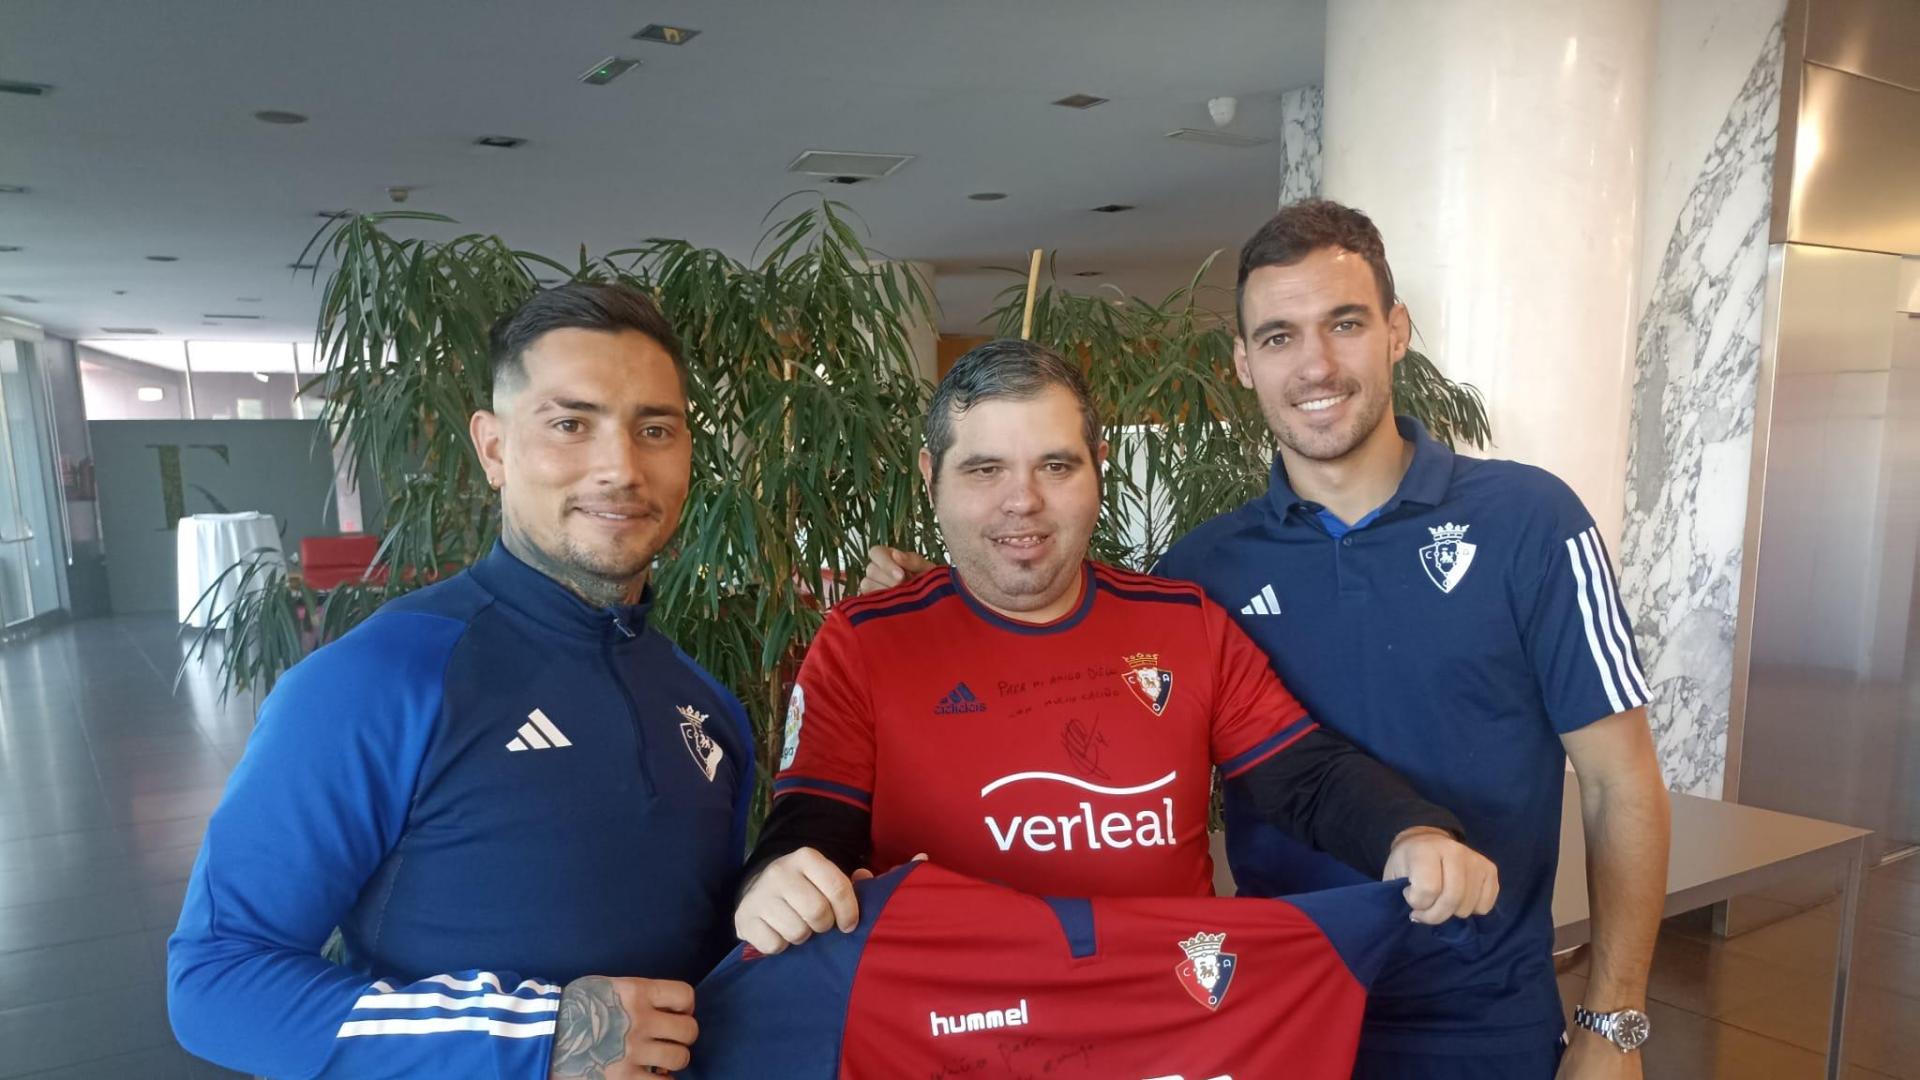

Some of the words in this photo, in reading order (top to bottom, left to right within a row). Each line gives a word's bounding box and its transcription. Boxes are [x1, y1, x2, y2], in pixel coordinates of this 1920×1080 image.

[933, 702, 988, 715] adidas
[984, 797, 1177, 852] verleal
[930, 999, 1029, 1037] hummel
